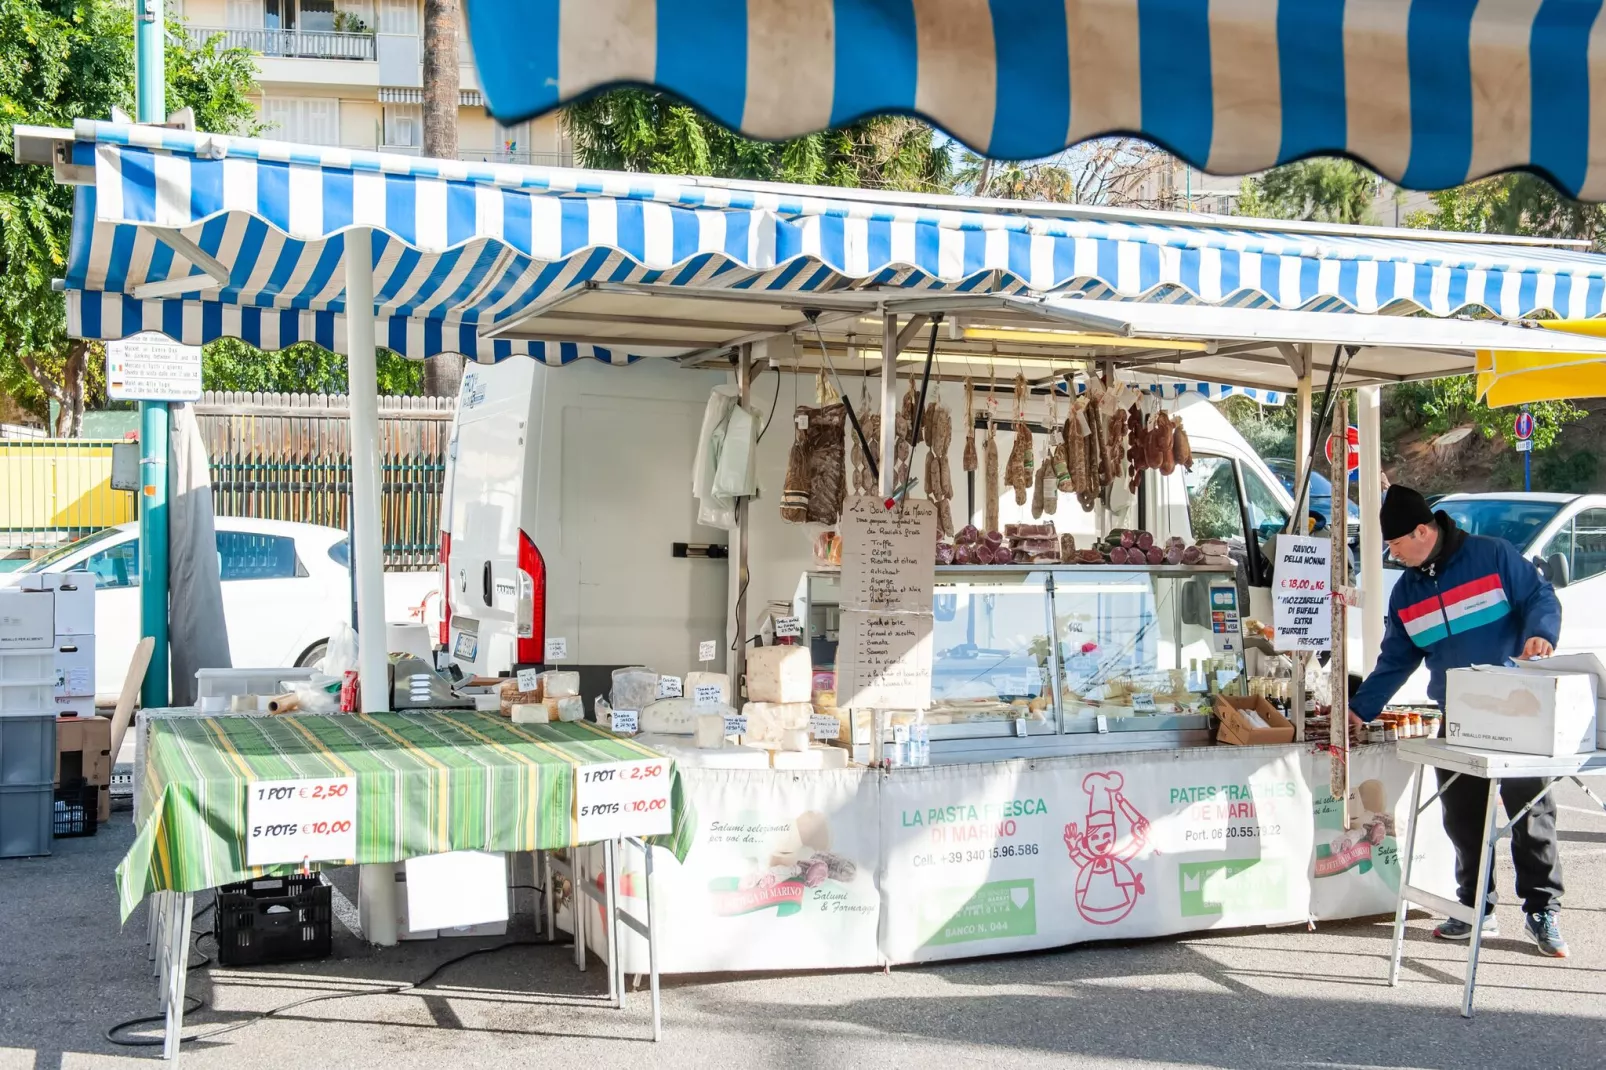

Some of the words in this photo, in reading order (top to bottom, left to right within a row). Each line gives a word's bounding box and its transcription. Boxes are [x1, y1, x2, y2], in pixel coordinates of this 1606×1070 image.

[850, 498, 865, 512] La
[871, 540, 894, 550] Truffe
[1292, 545, 1317, 554] RAVIOLI
[1284, 555, 1302, 564] DELLA
[1304, 556, 1325, 565] NONNA
[870, 578, 894, 588] Asperge
[1289, 579, 1310, 590] 18,00
[1316, 581, 1325, 590] KG
[584, 773, 589, 783] 1
[592, 769, 616, 782] POT
[619, 769, 628, 779] €
[630, 765, 662, 780] 2,50
[258, 789, 264, 800] 1
[268, 787, 295, 800] POT
[299, 787, 308, 798] €
[312, 784, 348, 800] 2,50
[1170, 786, 1216, 804] PATES
[581, 806, 588, 816] 5
[592, 803, 619, 816] POTS
[902, 810, 923, 827] LA
[928, 805, 978, 825] PASTA
[1192, 806, 1210, 820] DE
[253, 826, 261, 837] 5
[265, 824, 297, 836] POTS
[710, 821, 744, 832] Salumi
[747, 823, 790, 834] selezionati
[931, 827, 946, 843] DI
[952, 820, 1016, 842] MARINO
[708, 835, 723, 844] per
[726, 834, 740, 843] voi
[1185, 830, 1208, 841] Port.
[1212, 828, 1223, 839] 06
[913, 854, 936, 867] Cell.
[940, 852, 963, 863] +39
[966, 850, 985, 862] 340
[988, 844, 1039, 859] 15.96.586
[770, 886, 802, 898] MARINO
[813, 890, 847, 900] Salumi
[821, 902, 828, 911] &
[831, 902, 876, 917] Formaggi
[946, 924, 975, 938] BANCO
[977, 924, 986, 933] N.
[990, 922, 1008, 931] 044
